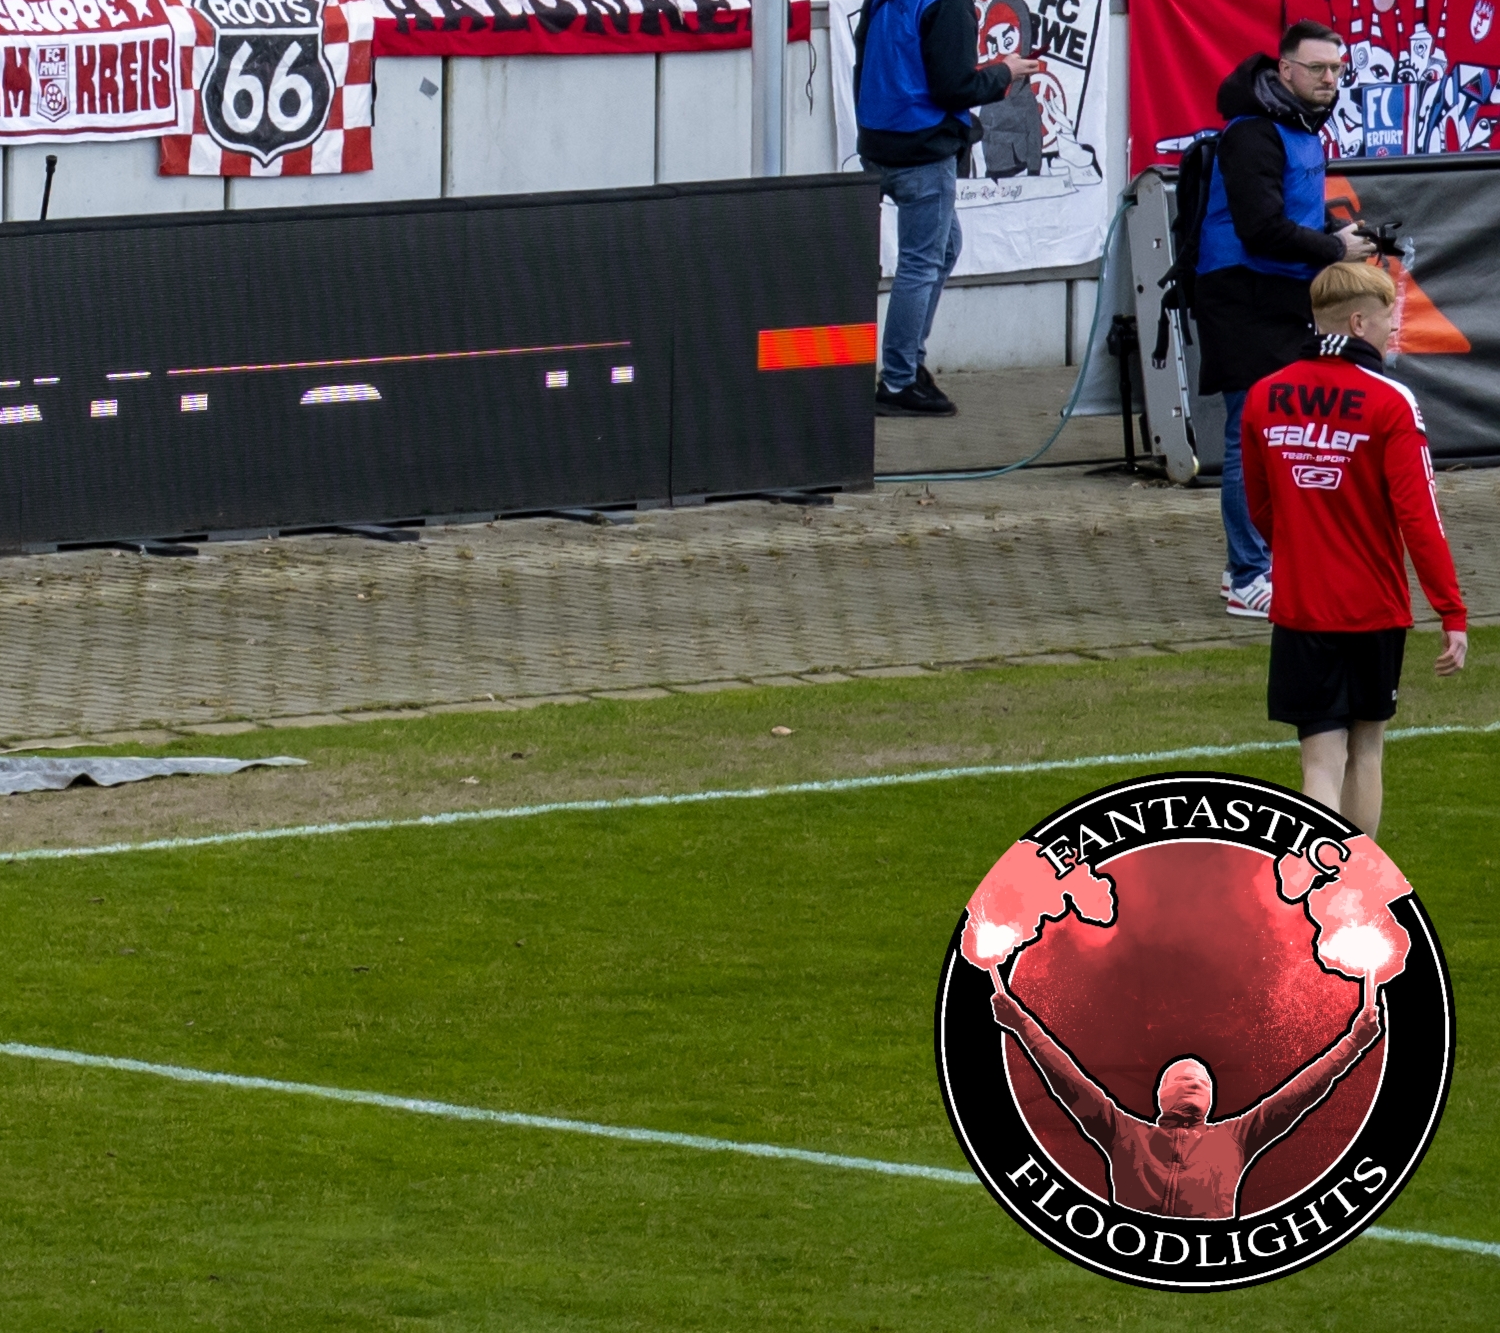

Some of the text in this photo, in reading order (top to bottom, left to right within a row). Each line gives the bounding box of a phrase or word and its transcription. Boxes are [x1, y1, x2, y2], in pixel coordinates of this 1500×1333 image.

[39, 60, 67, 77] RWE
[44, 48, 63, 62] FC
[75, 38, 172, 115] KREIS
[220, 40, 314, 134] 66
[1366, 86, 1394, 130] FC
[1366, 130, 1404, 145] ERFURT
[1267, 382, 1369, 423] RWE
[1263, 422, 1372, 454] saller
